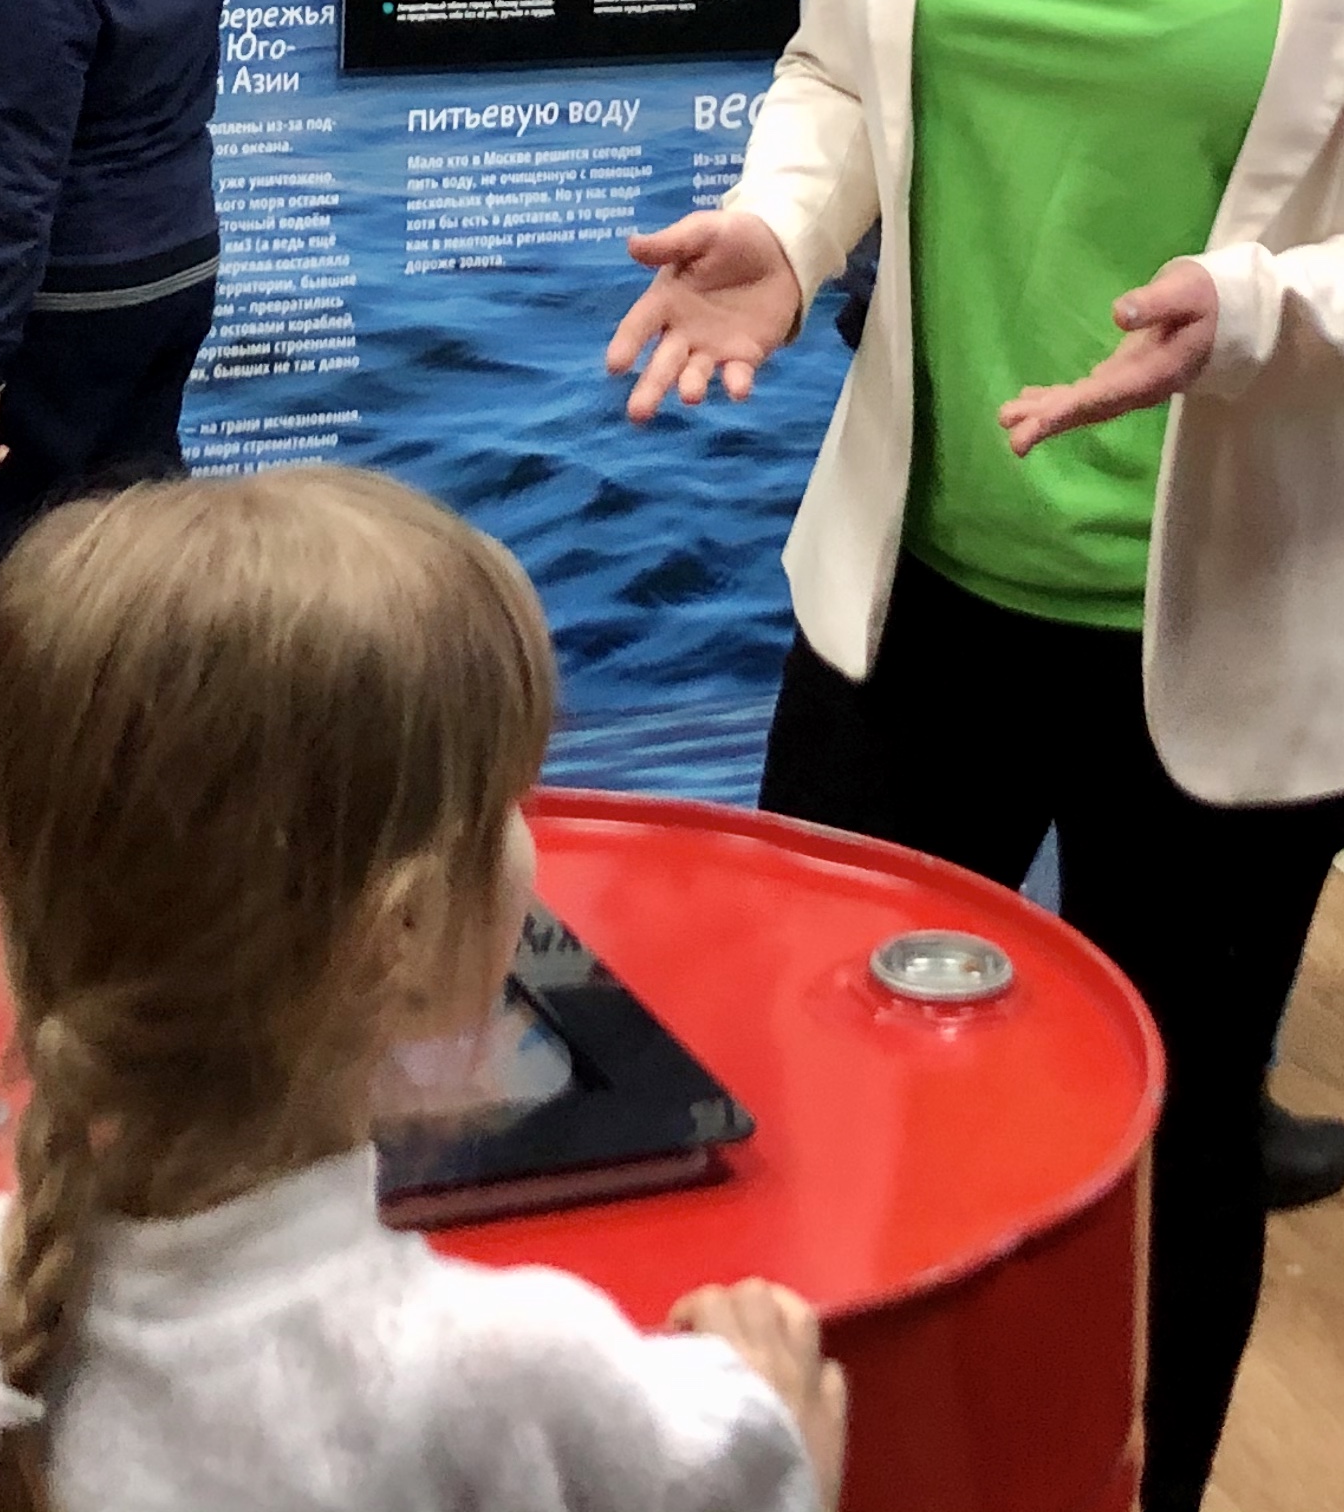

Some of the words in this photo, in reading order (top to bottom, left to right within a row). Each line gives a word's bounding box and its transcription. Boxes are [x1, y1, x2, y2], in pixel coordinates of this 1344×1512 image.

[227, 31, 296, 61] Юго-
[231, 66, 299, 94] Азии
[407, 100, 560, 137] питьевую
[568, 96, 641, 132] воду
